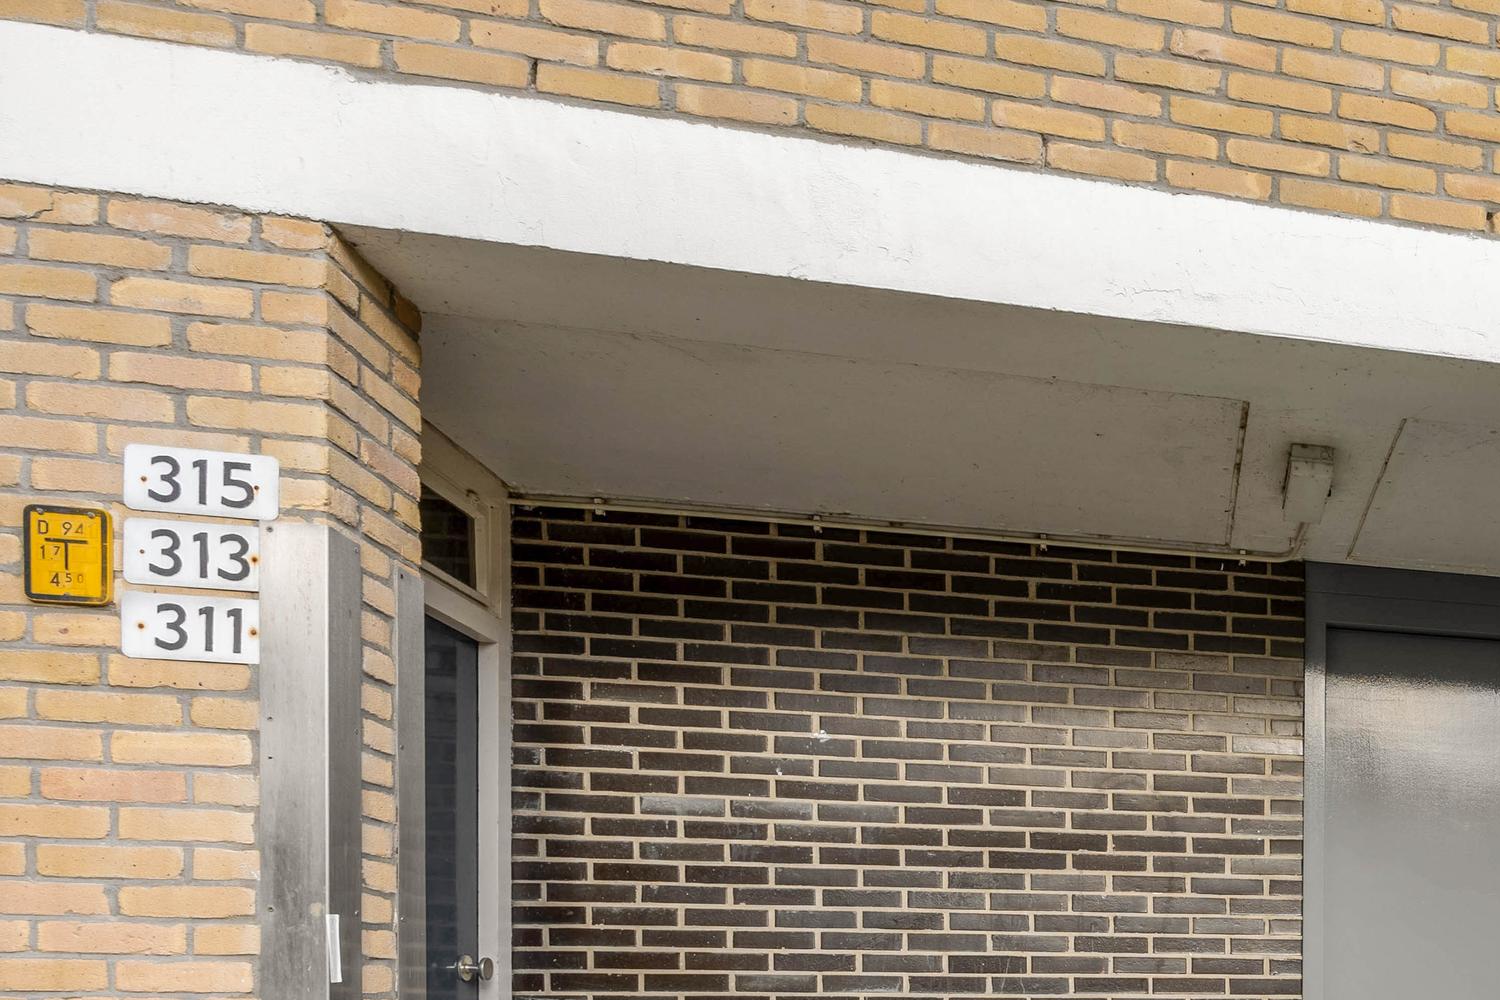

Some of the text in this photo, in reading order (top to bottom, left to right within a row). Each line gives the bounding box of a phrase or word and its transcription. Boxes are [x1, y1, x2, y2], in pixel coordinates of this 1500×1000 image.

[148, 455, 255, 509] 315
[37, 519, 84, 535] D 94
[149, 528, 250, 581] 313
[154, 602, 243, 654] 311
